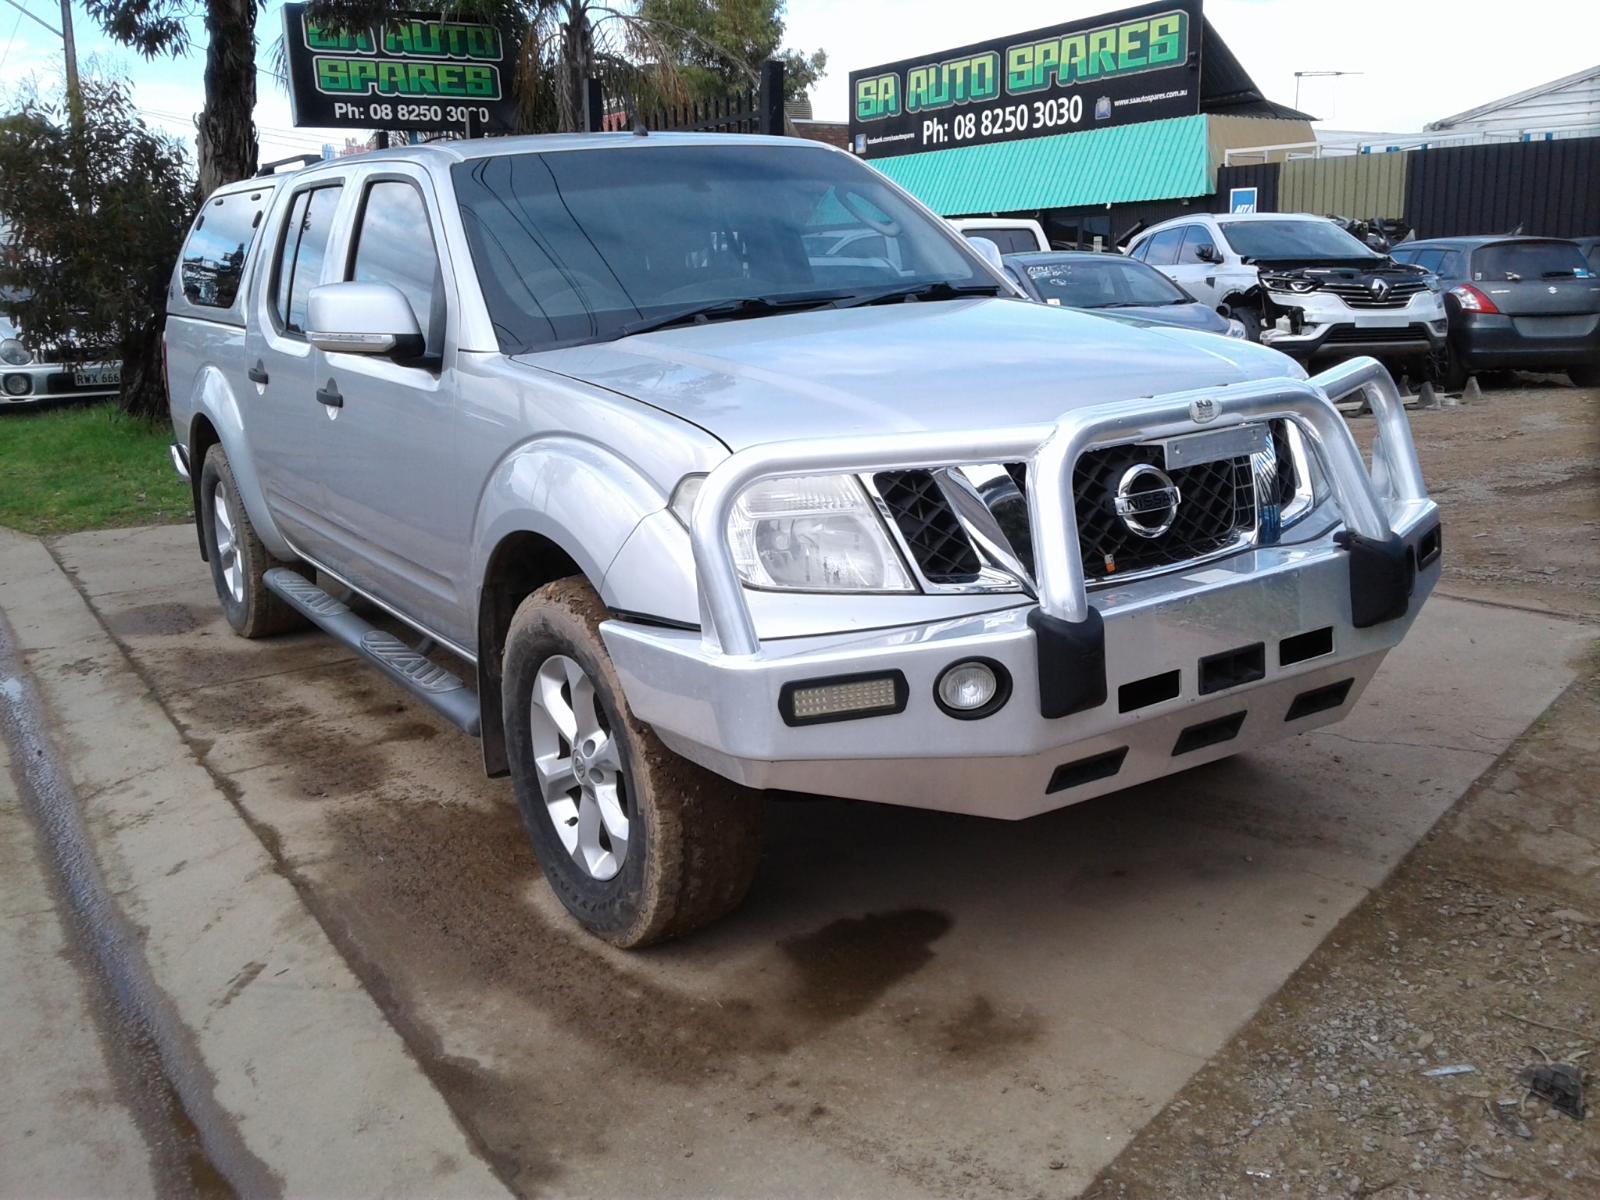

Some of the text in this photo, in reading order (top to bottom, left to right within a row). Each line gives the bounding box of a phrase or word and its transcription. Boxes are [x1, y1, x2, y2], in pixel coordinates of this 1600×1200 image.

[386, 21, 496, 55] AUTO
[318, 59, 493, 96] SPARES
[858, 14, 1180, 117] SA AUTO SPARES
[334, 103, 489, 123] Ph: 08 8250 300
[923, 95, 1083, 145] Ph: 08 8250 3030
[77, 372, 120, 384] RWX 666
